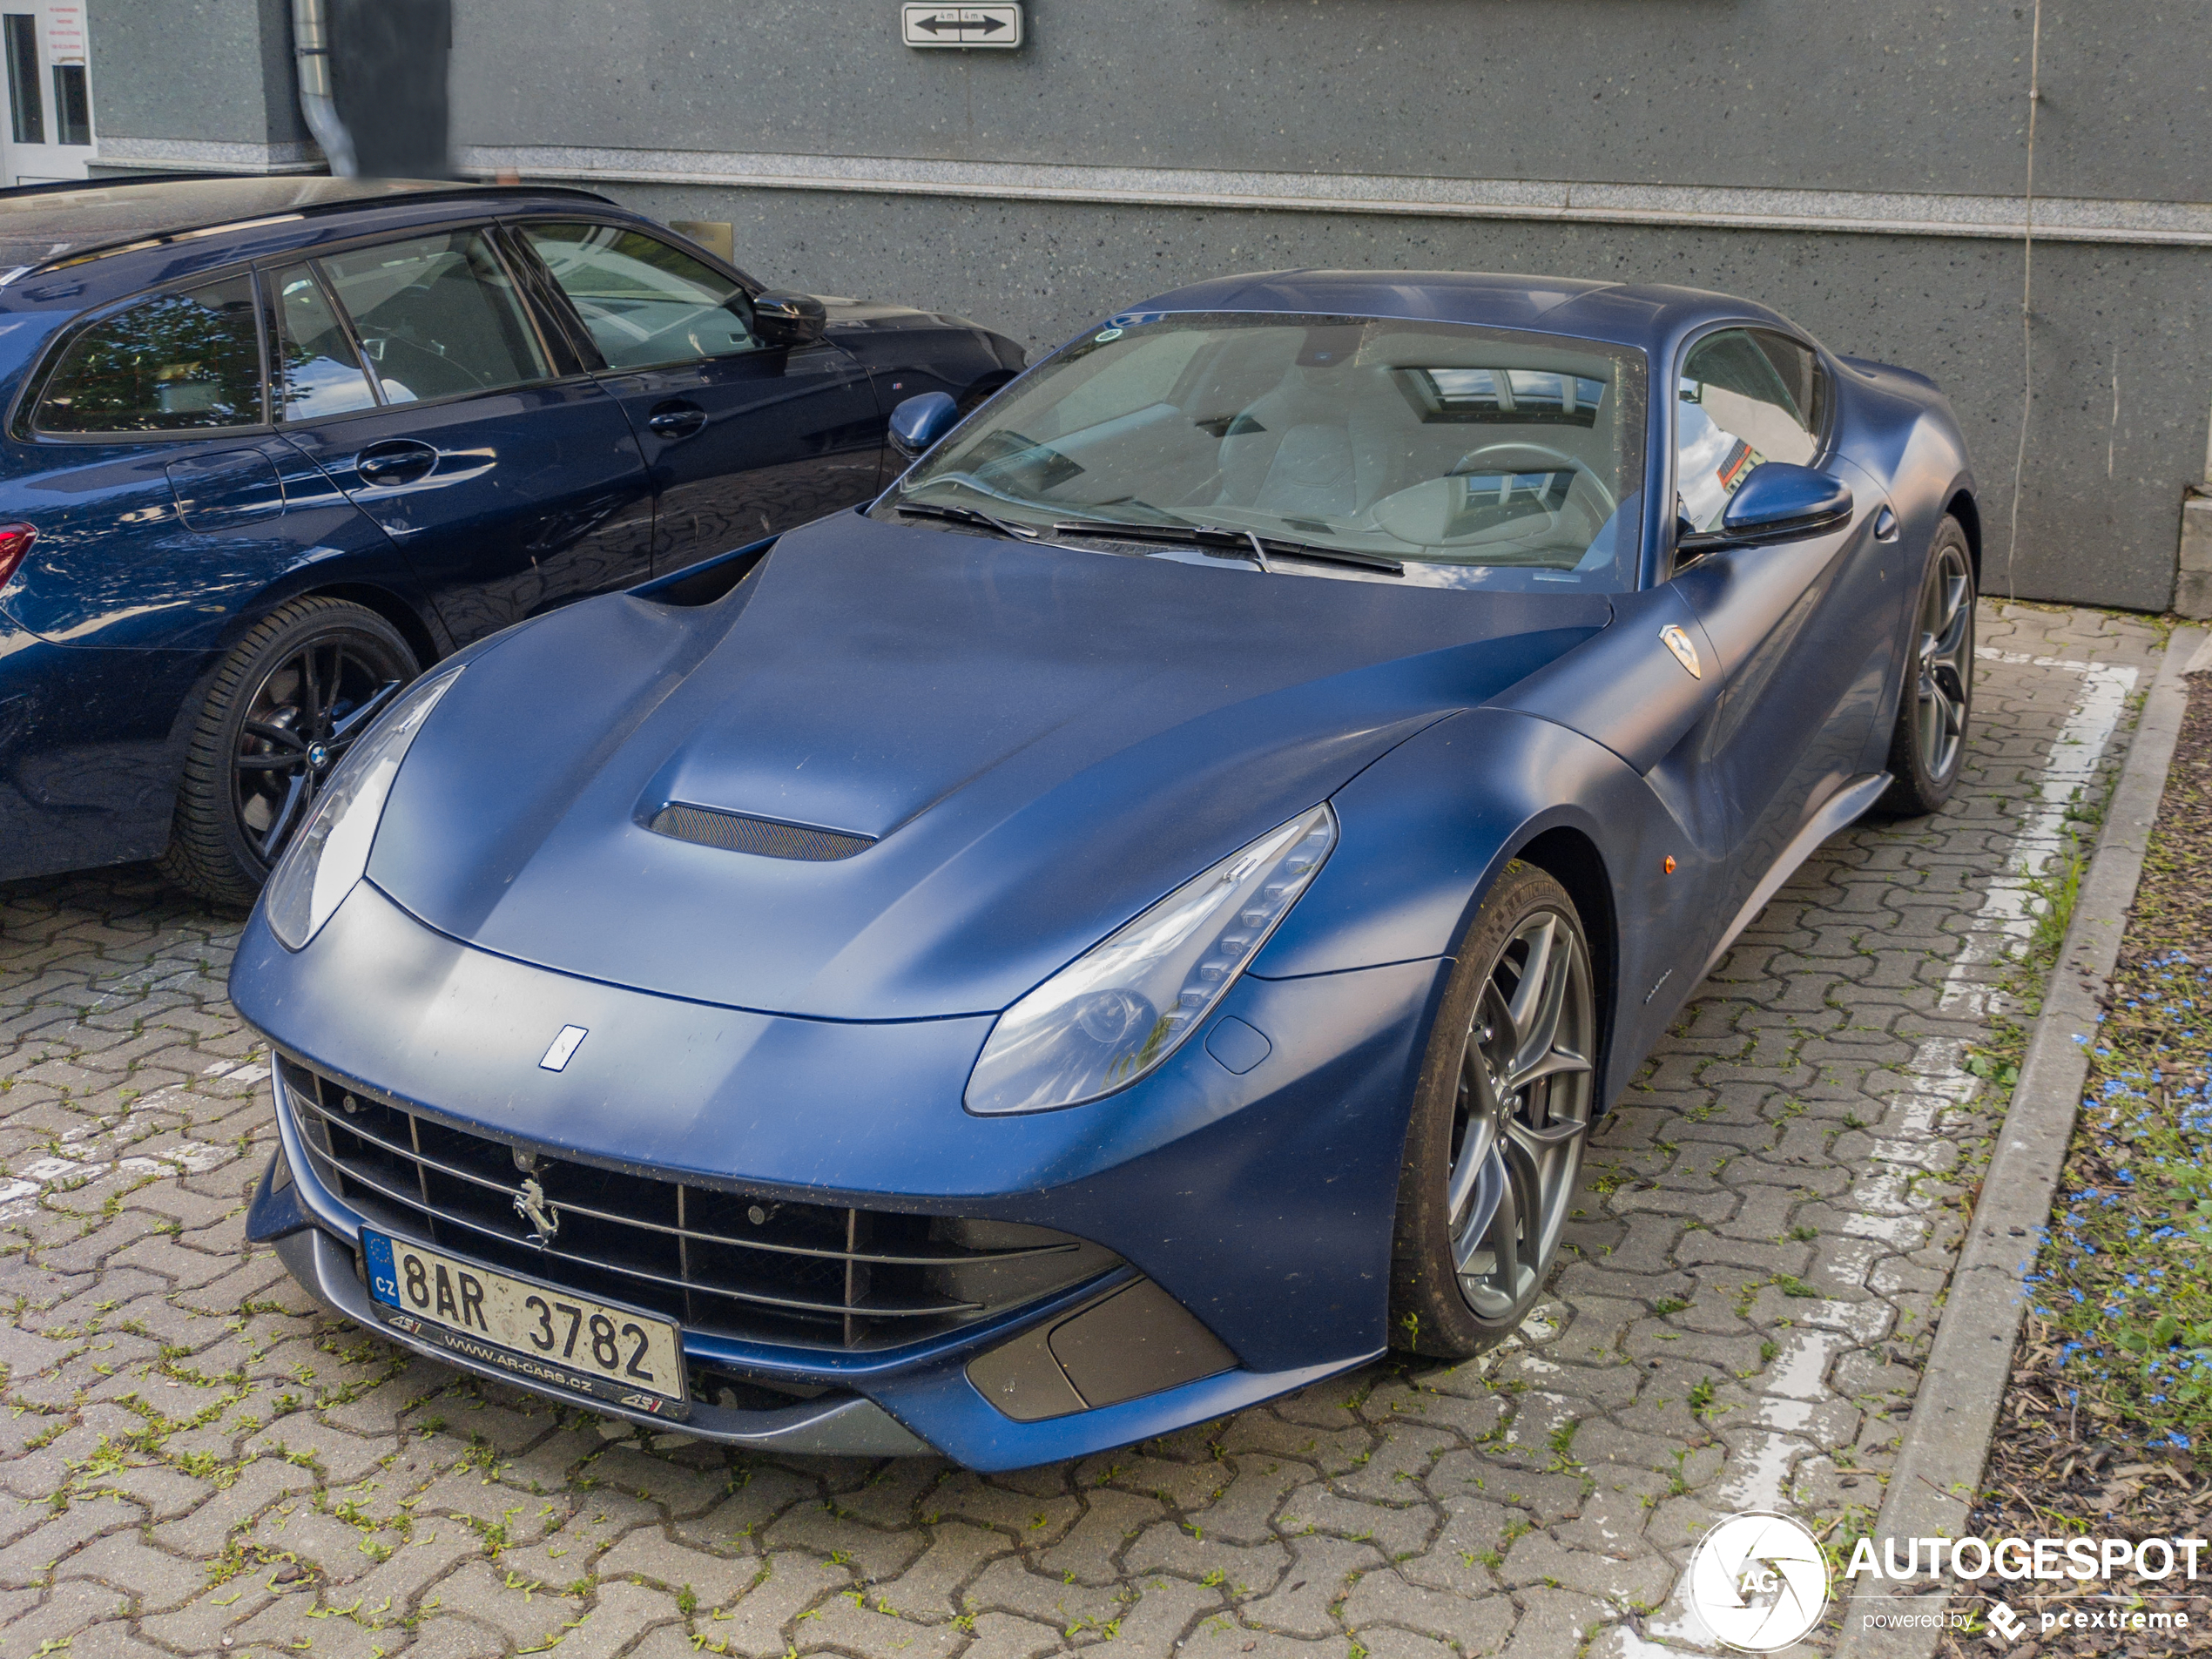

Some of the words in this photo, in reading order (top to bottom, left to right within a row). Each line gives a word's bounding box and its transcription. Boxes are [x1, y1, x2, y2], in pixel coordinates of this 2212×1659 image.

[375, 1277, 396, 1297] CZ
[403, 1254, 489, 1332] 8AR
[525, 1295, 654, 1382] 3782
[445, 1335, 593, 1393] WWW.AR-CARS.CZ
